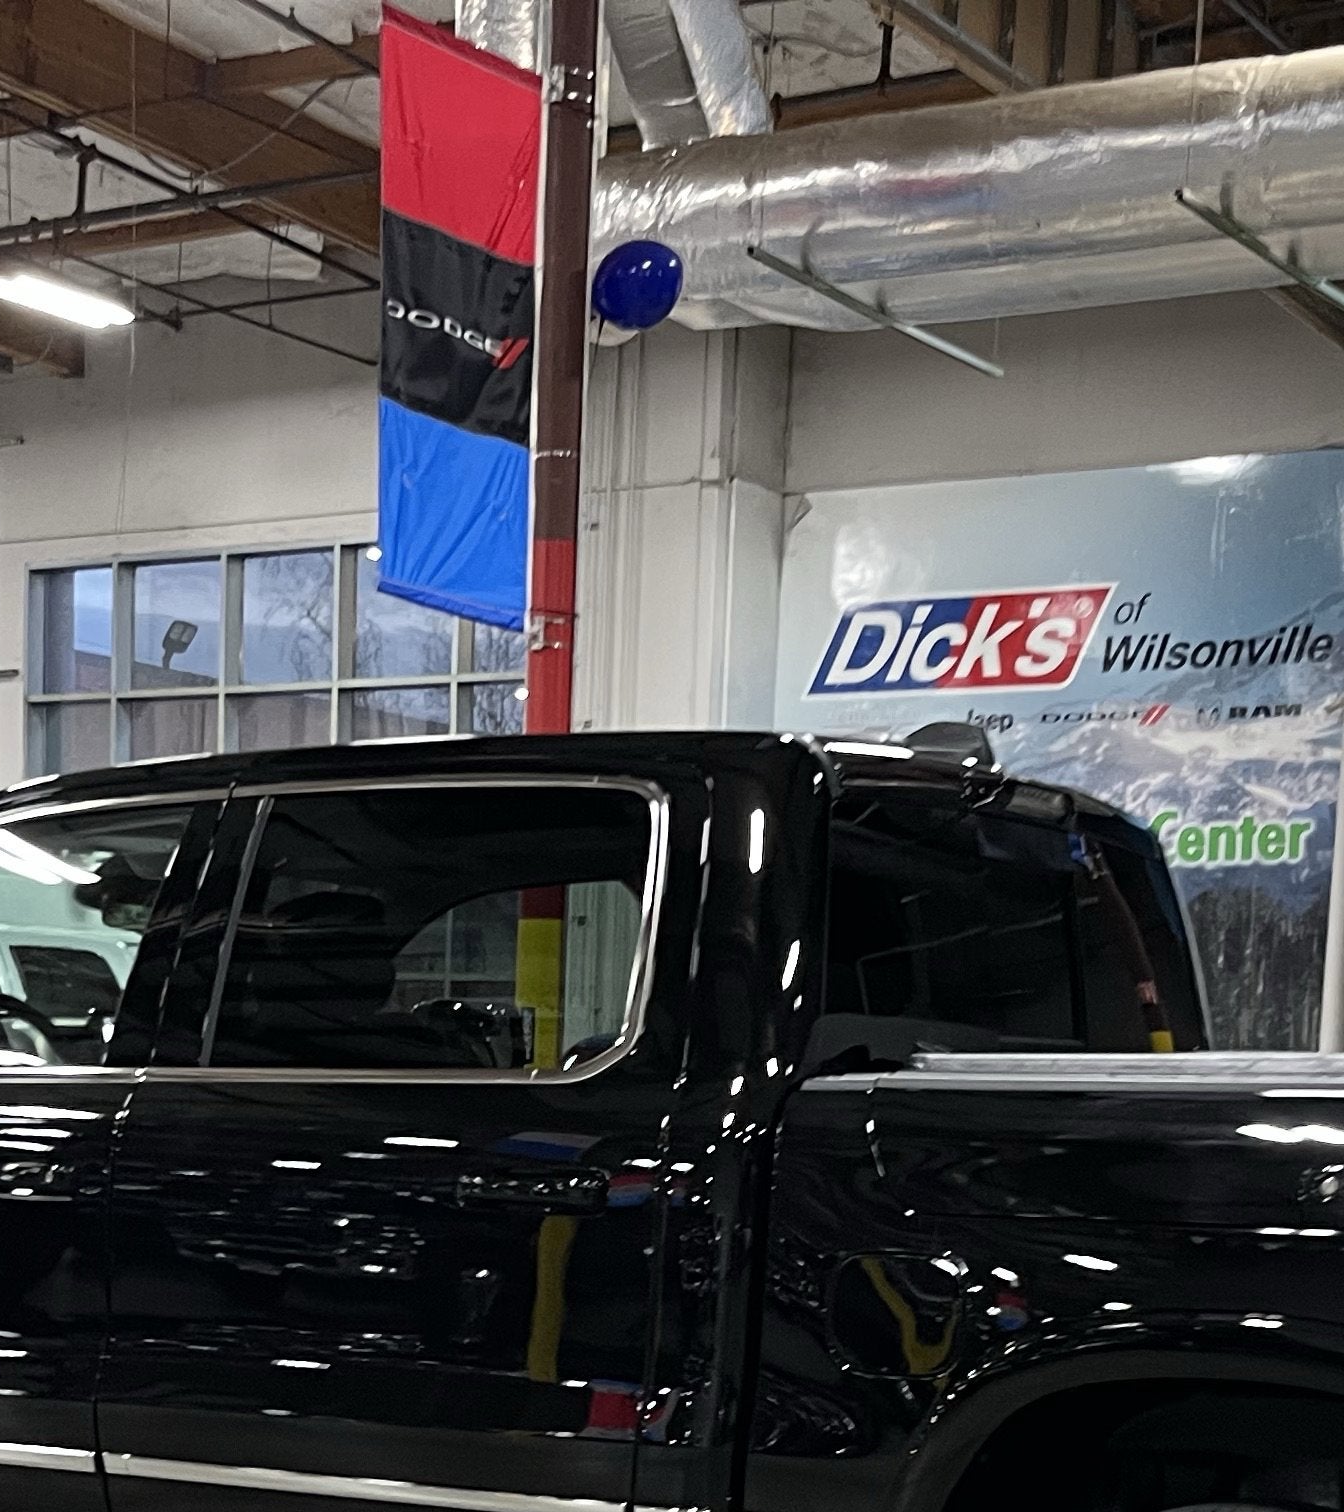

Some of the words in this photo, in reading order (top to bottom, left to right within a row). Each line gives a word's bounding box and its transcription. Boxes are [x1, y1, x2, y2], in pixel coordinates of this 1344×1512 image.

[1113, 593, 1152, 625] of
[1102, 622, 1334, 673] Wilsonville
[1228, 703, 1302, 721] RAM
